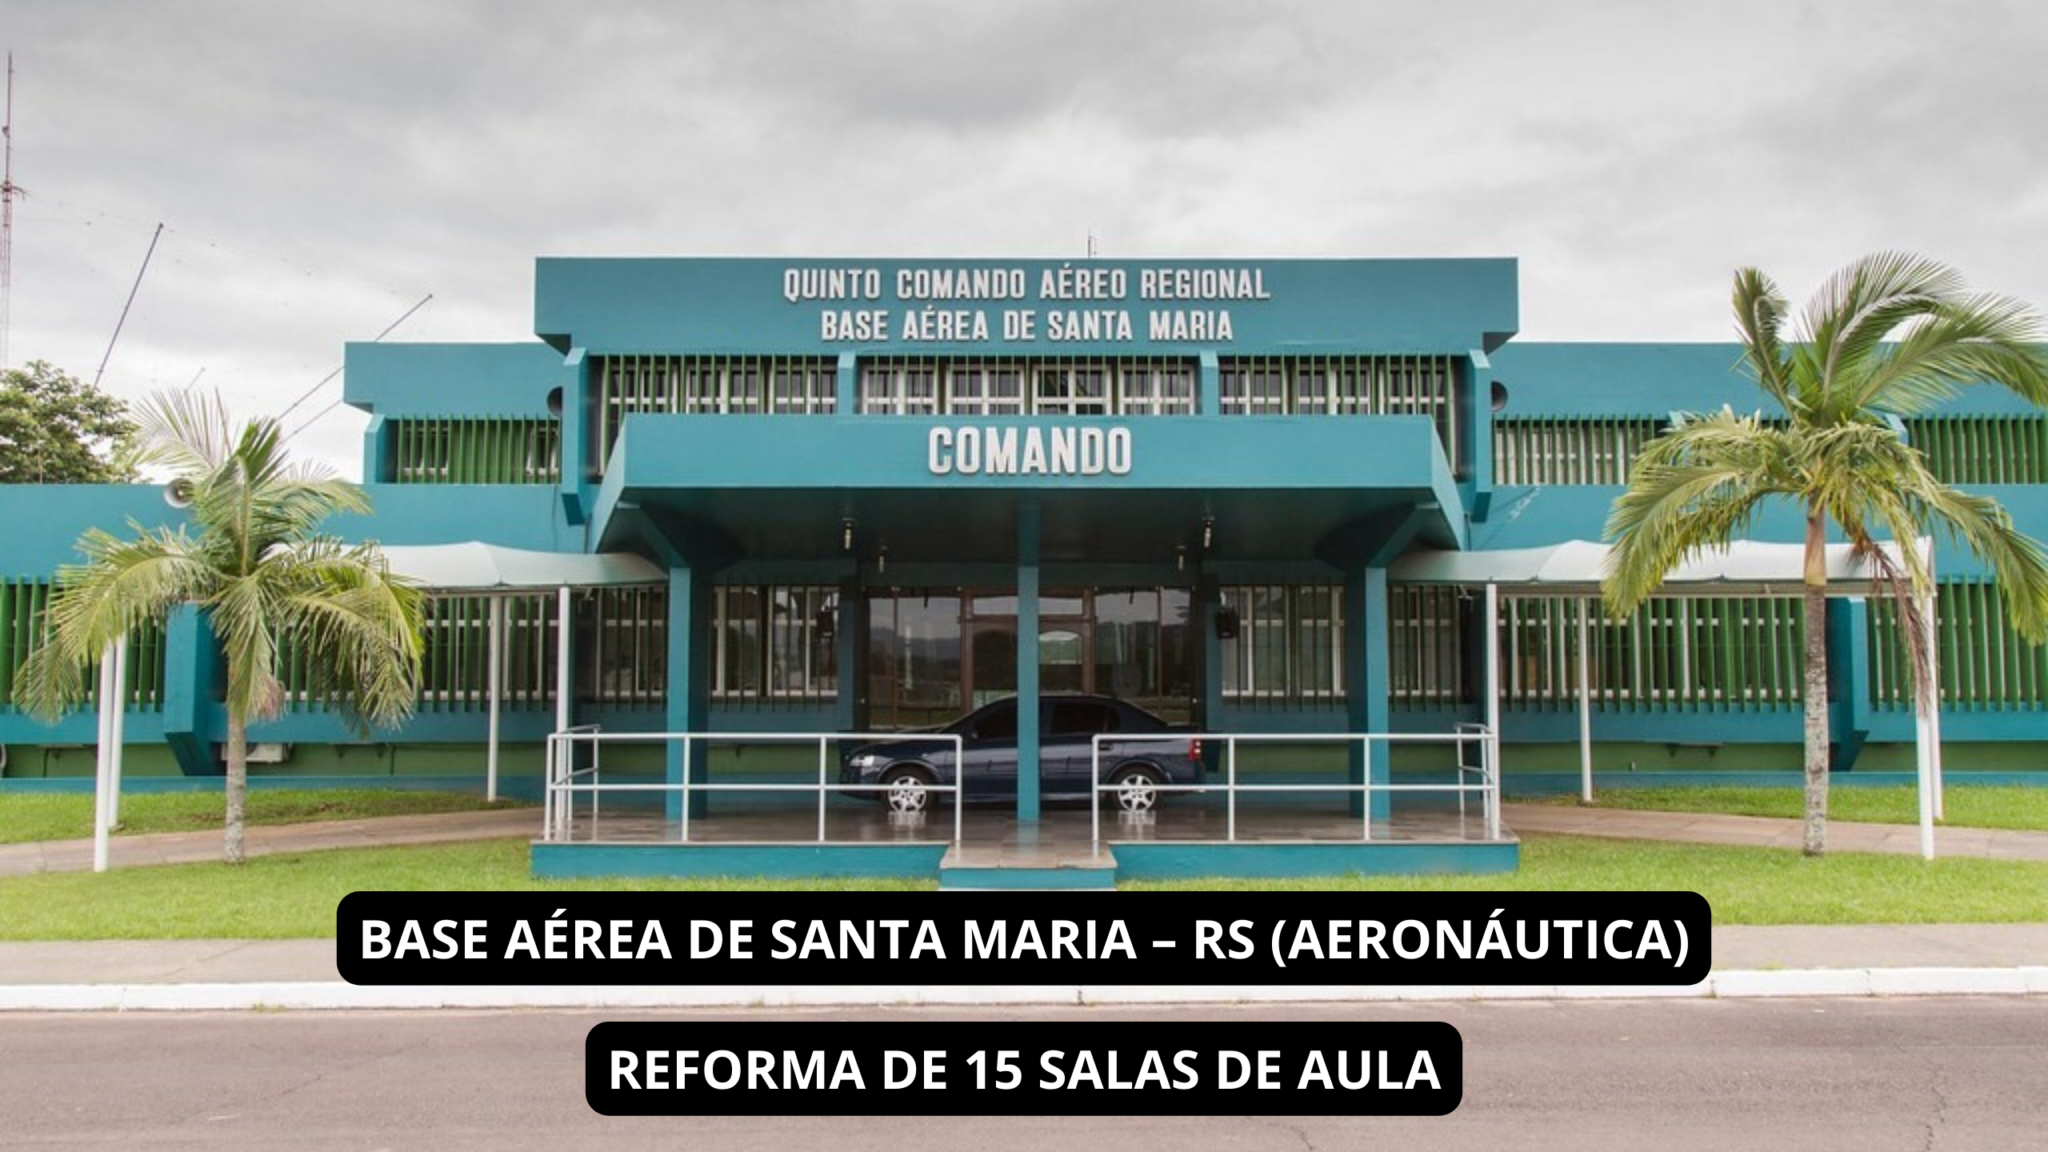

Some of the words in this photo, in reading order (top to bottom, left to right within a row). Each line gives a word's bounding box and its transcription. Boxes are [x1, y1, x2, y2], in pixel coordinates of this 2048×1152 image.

[784, 268, 881, 302] QUINTO
[897, 268, 1026, 299] COMANDO
[1040, 263, 1127, 299] AÉREO
[1141, 269, 1271, 299] REGIONAL
[821, 310, 888, 341] BASE
[902, 304, 989, 341] AÉREA
[1003, 310, 1036, 341] DE
[1047, 310, 1133, 341] SANTA
[1149, 310, 1234, 341] MARIA
[928, 426, 1132, 475] COMANDO
